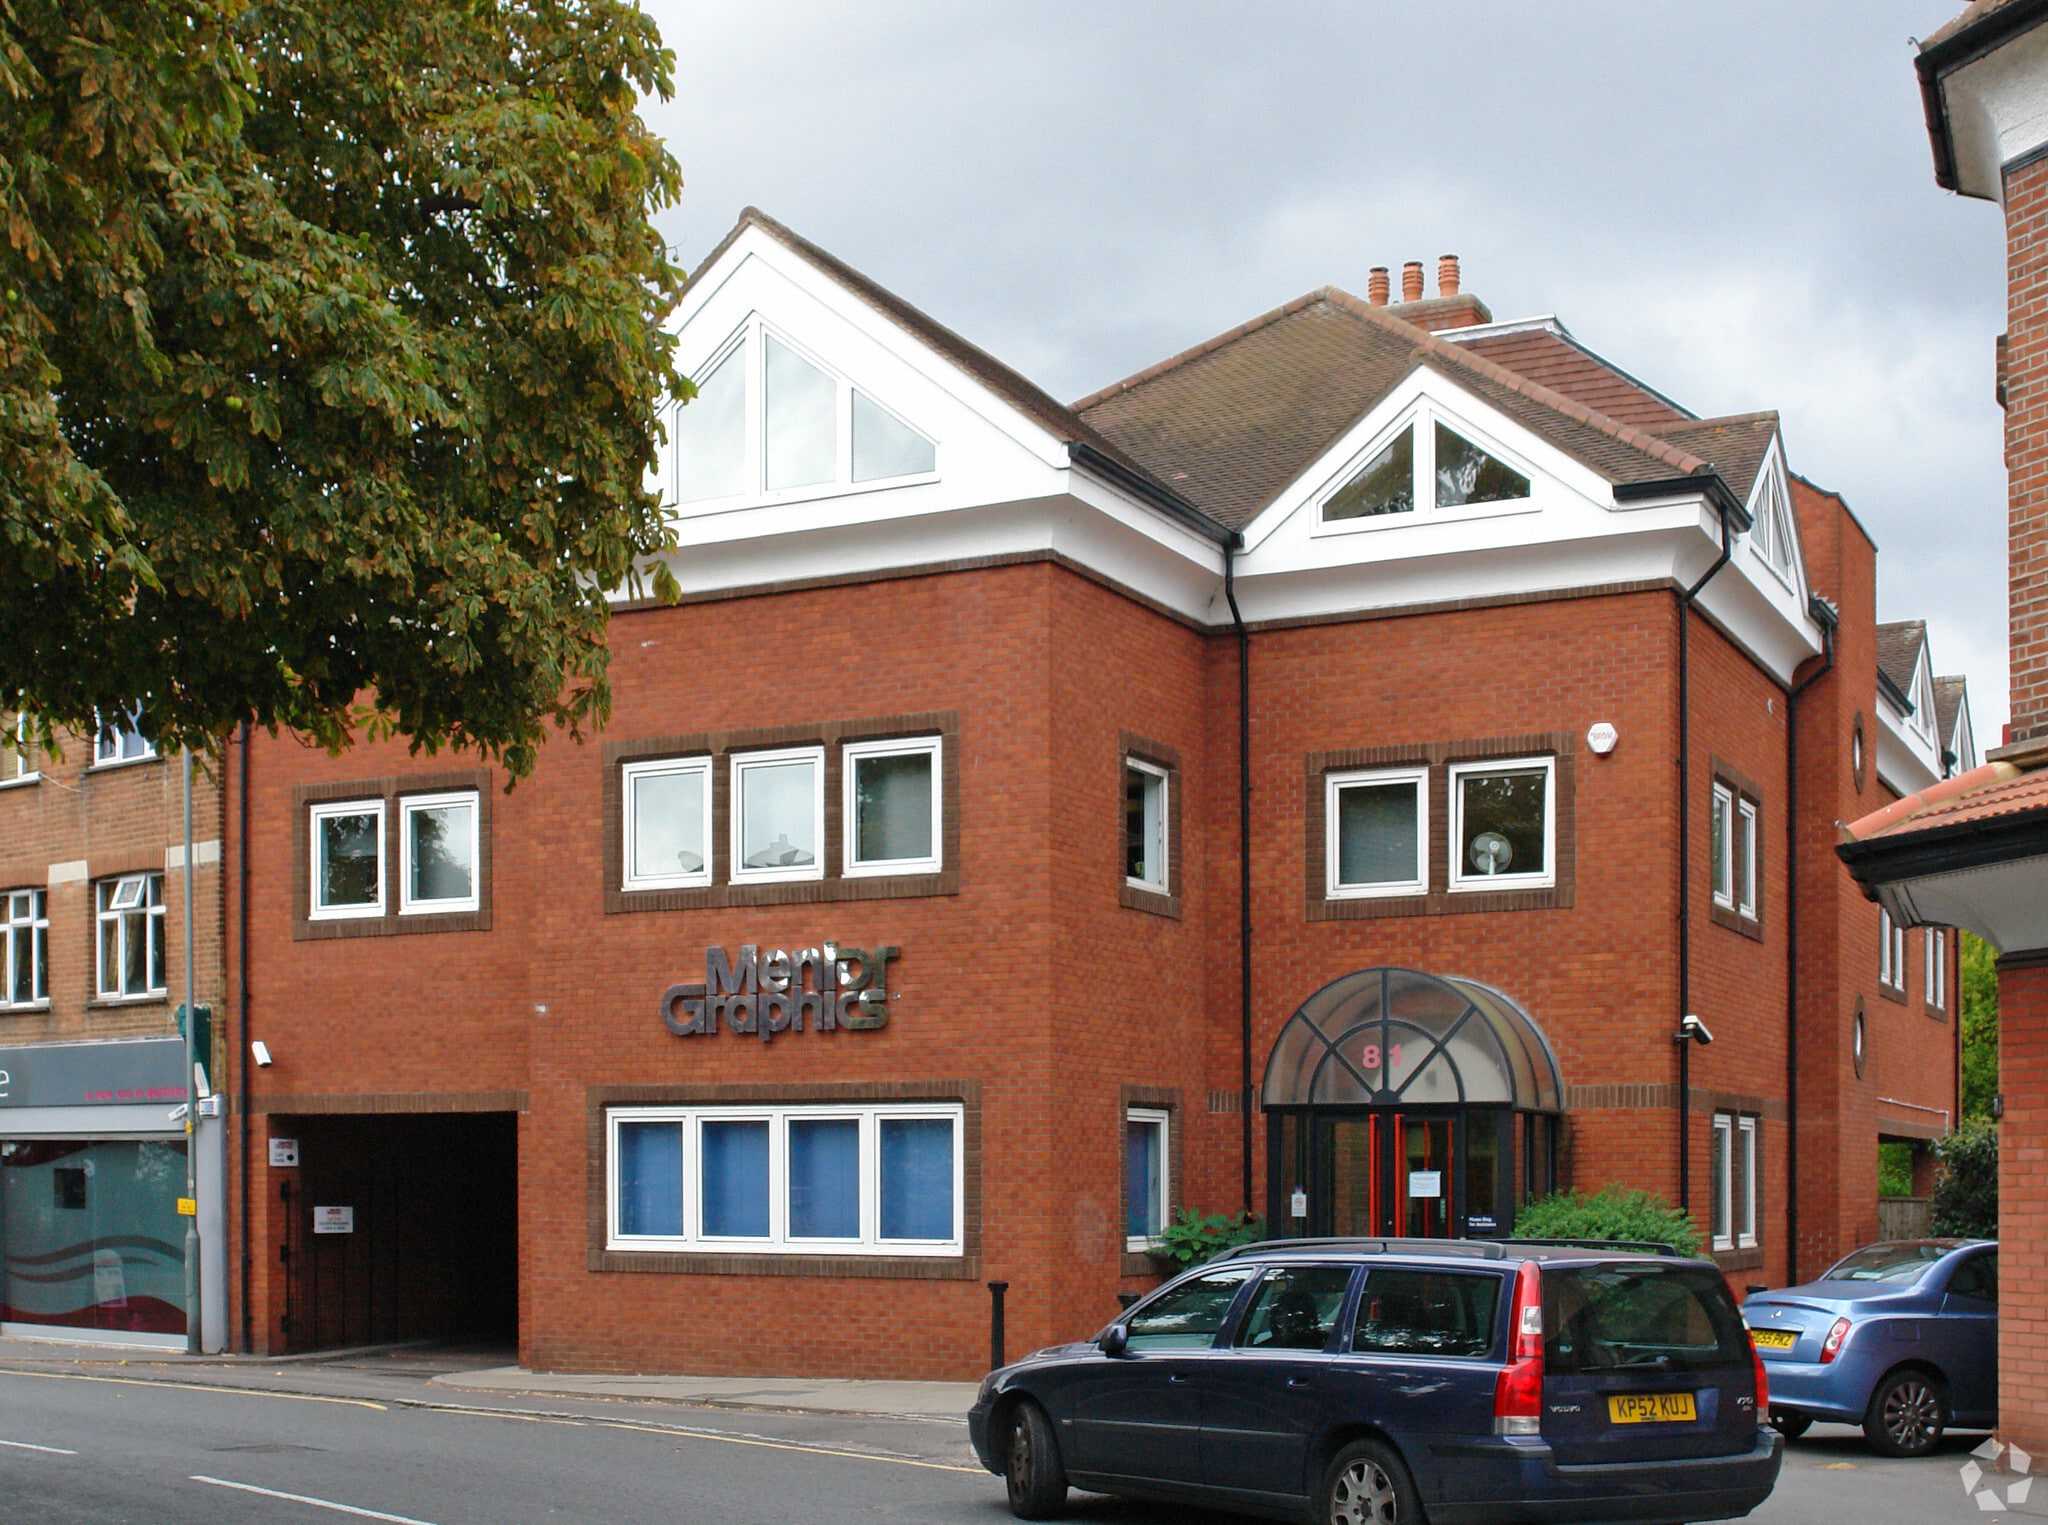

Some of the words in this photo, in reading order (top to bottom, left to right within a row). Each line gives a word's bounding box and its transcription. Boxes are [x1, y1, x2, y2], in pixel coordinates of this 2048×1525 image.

[661, 983, 889, 1041] Graphics
[1362, 1044, 1402, 1069] 81
[1617, 1397, 1657, 1418] KP52
[1660, 1395, 1689, 1416] KUJ
